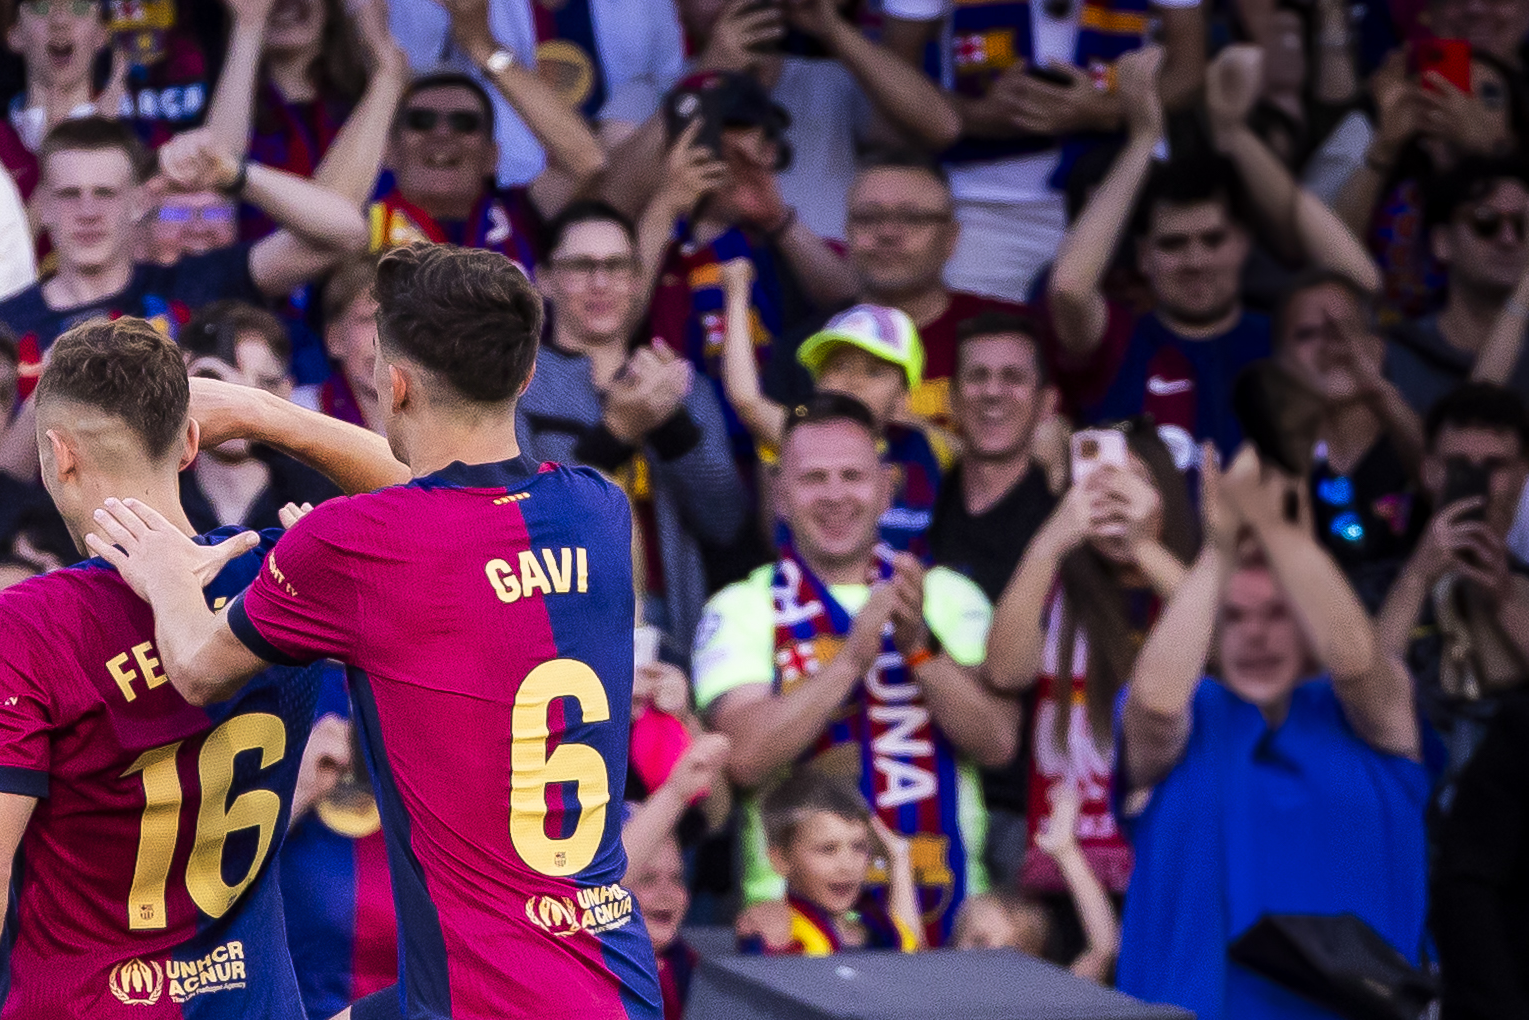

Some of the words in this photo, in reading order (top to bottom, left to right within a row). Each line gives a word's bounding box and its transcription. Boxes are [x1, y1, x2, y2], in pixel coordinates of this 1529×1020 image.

[484, 546, 589, 604] GAVI
[509, 658, 611, 878] 6
[119, 712, 287, 930] 16
[166, 940, 245, 979] UNHCR
[169, 961, 247, 996] ACNUR
